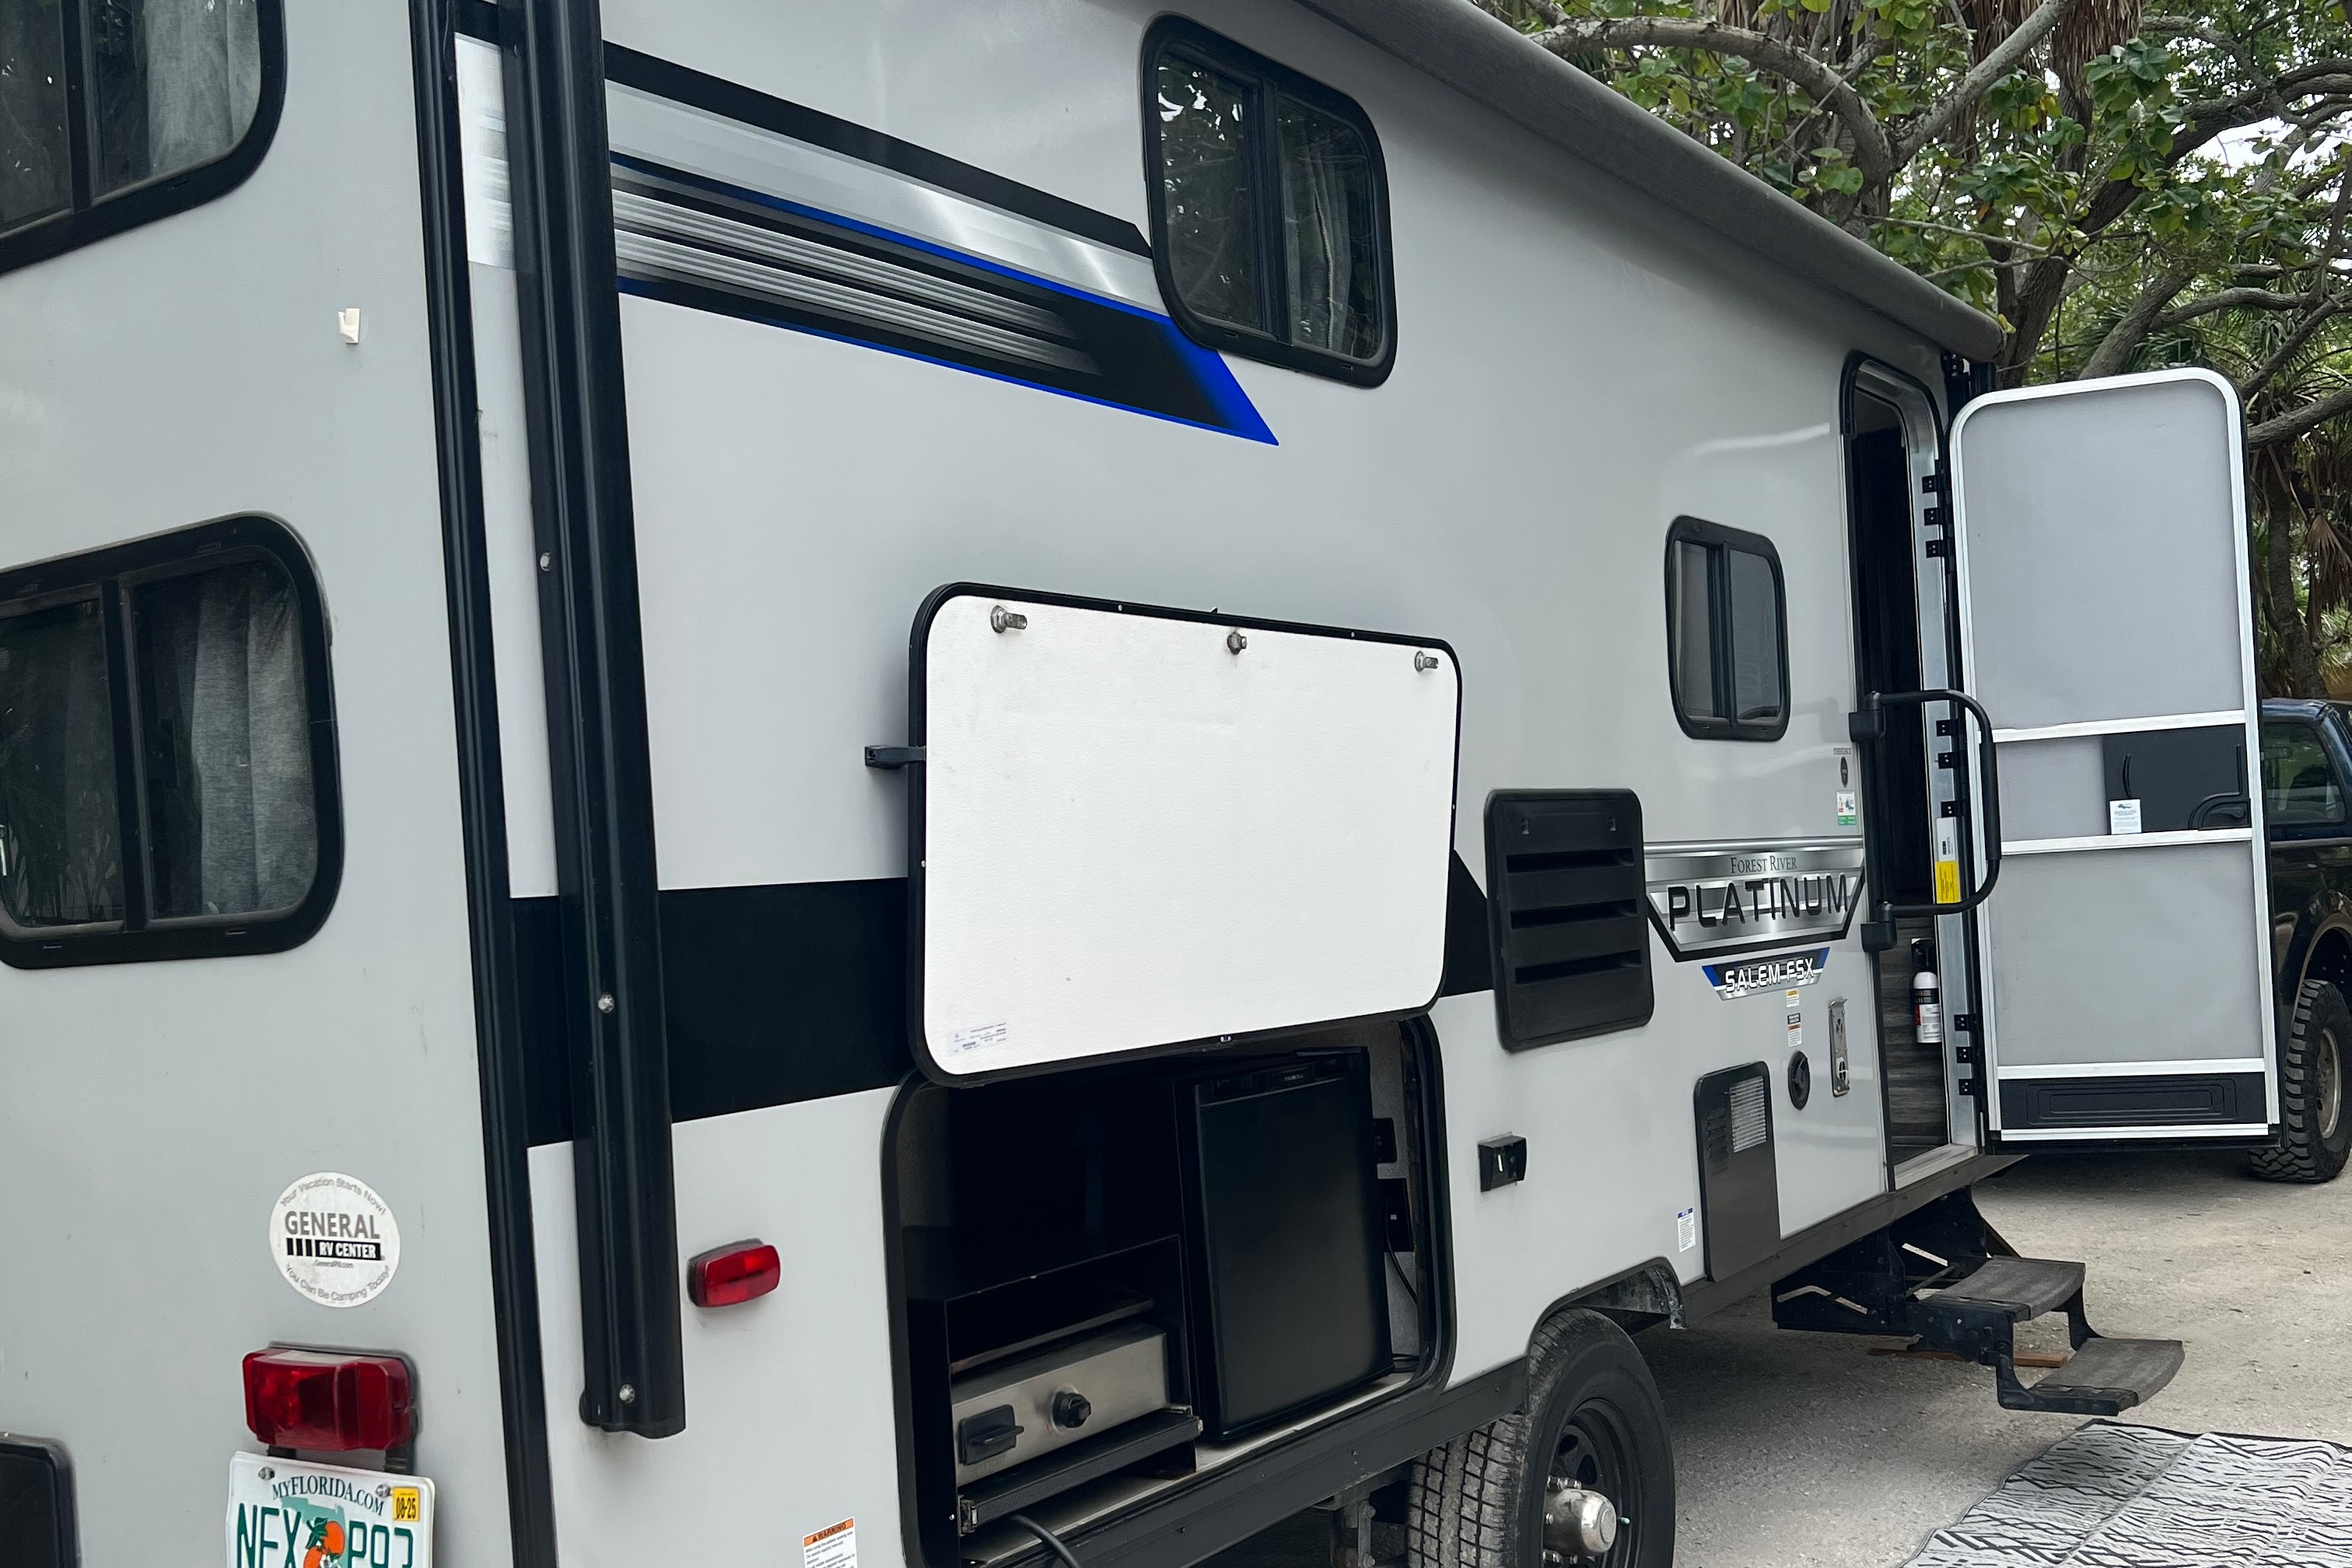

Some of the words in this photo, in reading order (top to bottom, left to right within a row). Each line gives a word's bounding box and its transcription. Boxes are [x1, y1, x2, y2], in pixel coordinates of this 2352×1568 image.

[1731, 856, 1767, 874] FOREST
[1769, 855, 1797, 871] RIVER
[1668, 873, 1848, 931] PLATINUM
[1725, 963, 1780, 993] SALEM
[1787, 957, 1815, 982] FSX
[280, 1188, 297, 1206] Your
[298, 1178, 334, 1193] Vacation
[336, 1178, 362, 1195] Starts
[364, 1191, 387, 1216] Now!
[285, 1210, 380, 1239] GENERAL
[319, 1241, 334, 1256] RV
[335, 1242, 376, 1258] CENTER
[286, 1263, 299, 1283] You
[300, 1279, 317, 1294] Can
[318, 1289, 330, 1299] Be
[331, 1288, 367, 1302] Camping
[272, 1475, 385, 1517] MYFLORIDA.COM
